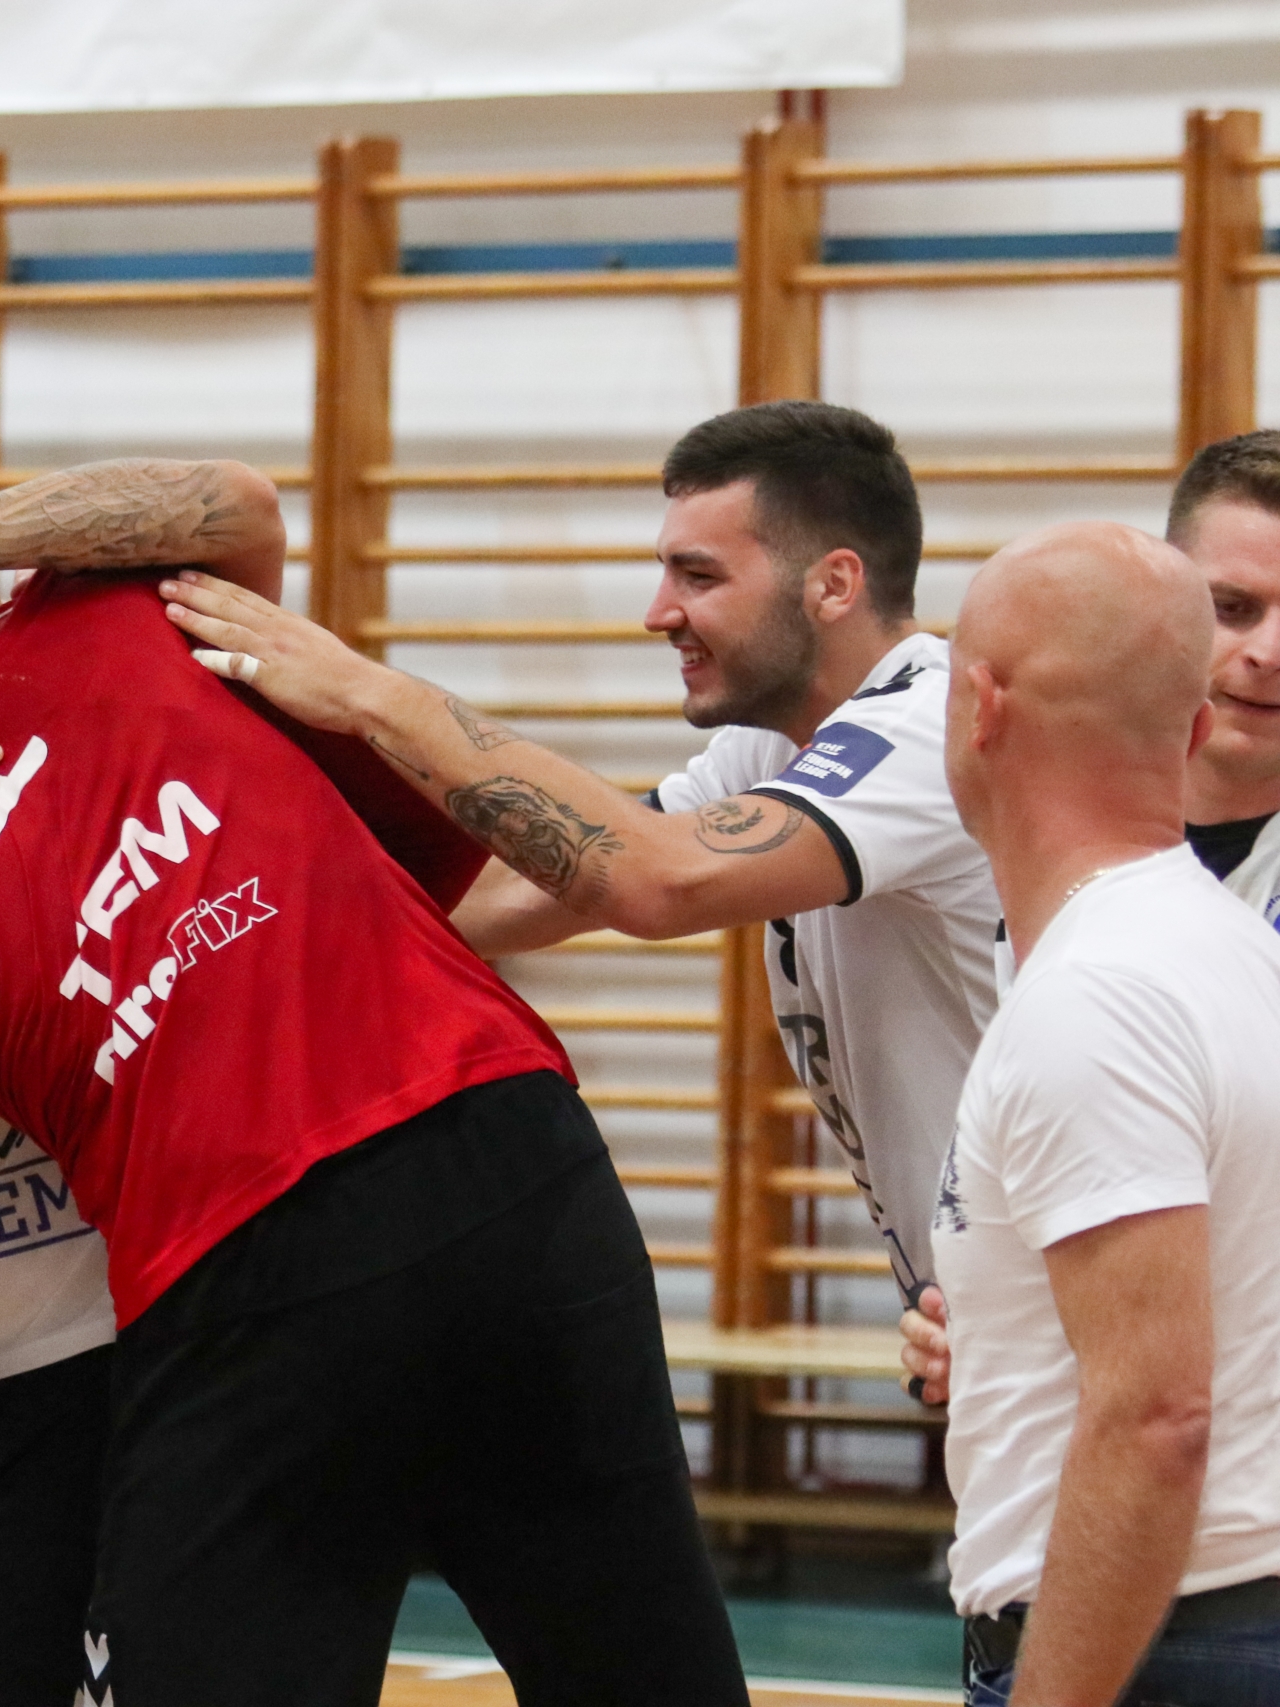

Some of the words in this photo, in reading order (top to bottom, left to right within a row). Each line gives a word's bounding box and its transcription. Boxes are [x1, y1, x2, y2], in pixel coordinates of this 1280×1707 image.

[793, 761, 831, 779] LEAGUE
[802, 752, 854, 779] EUROPEAN
[59, 781, 220, 1006] TEM
